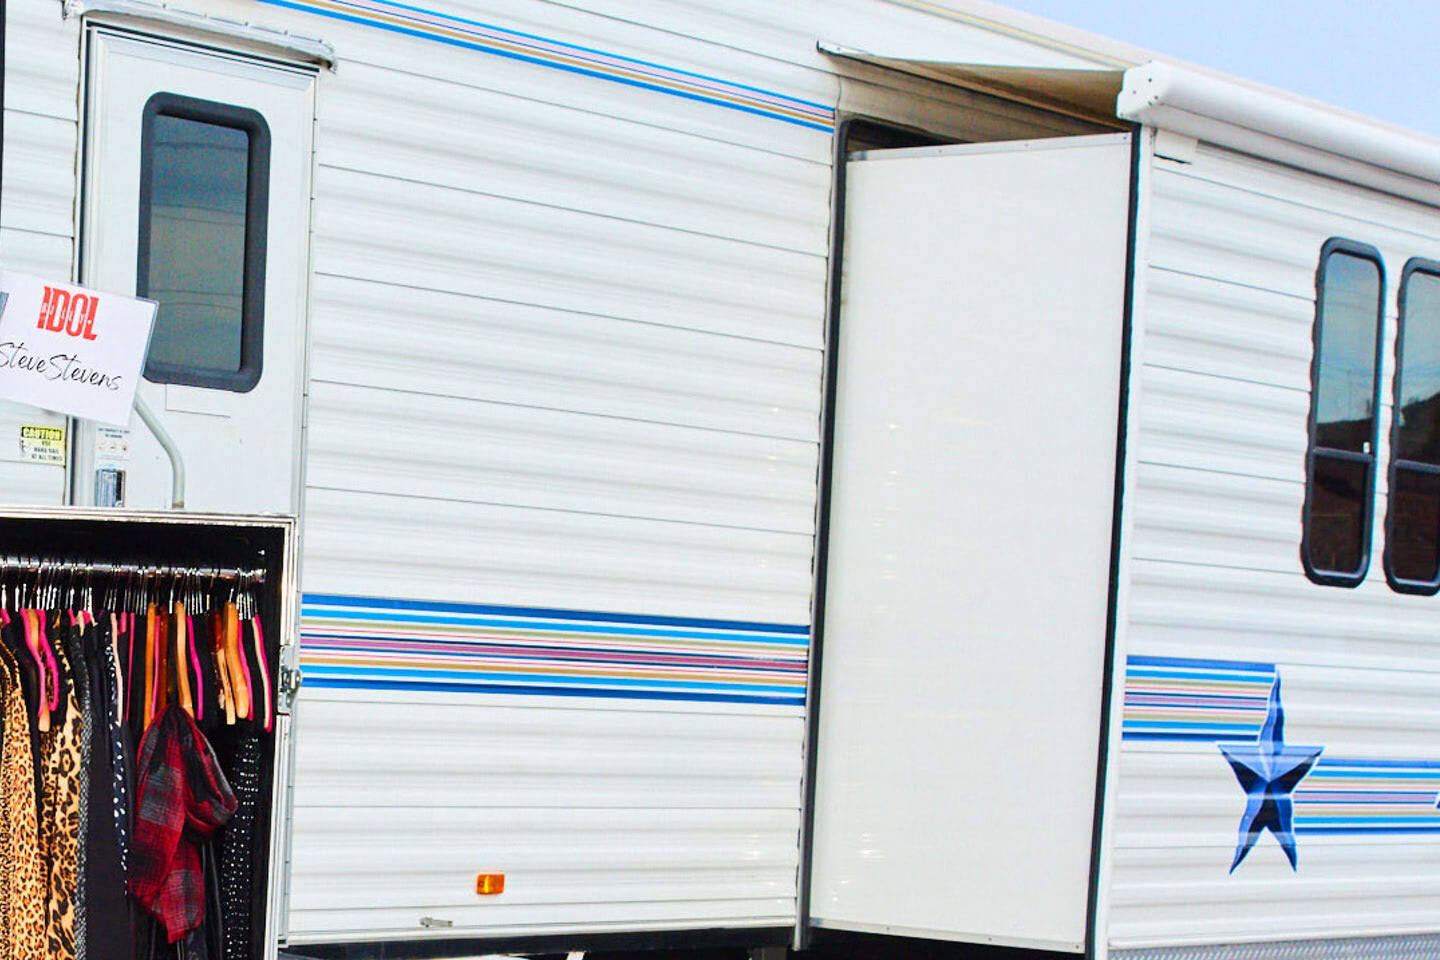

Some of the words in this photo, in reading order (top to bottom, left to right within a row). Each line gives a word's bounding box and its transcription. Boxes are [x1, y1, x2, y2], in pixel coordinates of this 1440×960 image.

[37, 286, 100, 341] IDOL
[46, 354, 123, 391] Stevens
[23, 428, 61, 440] CAUTION
